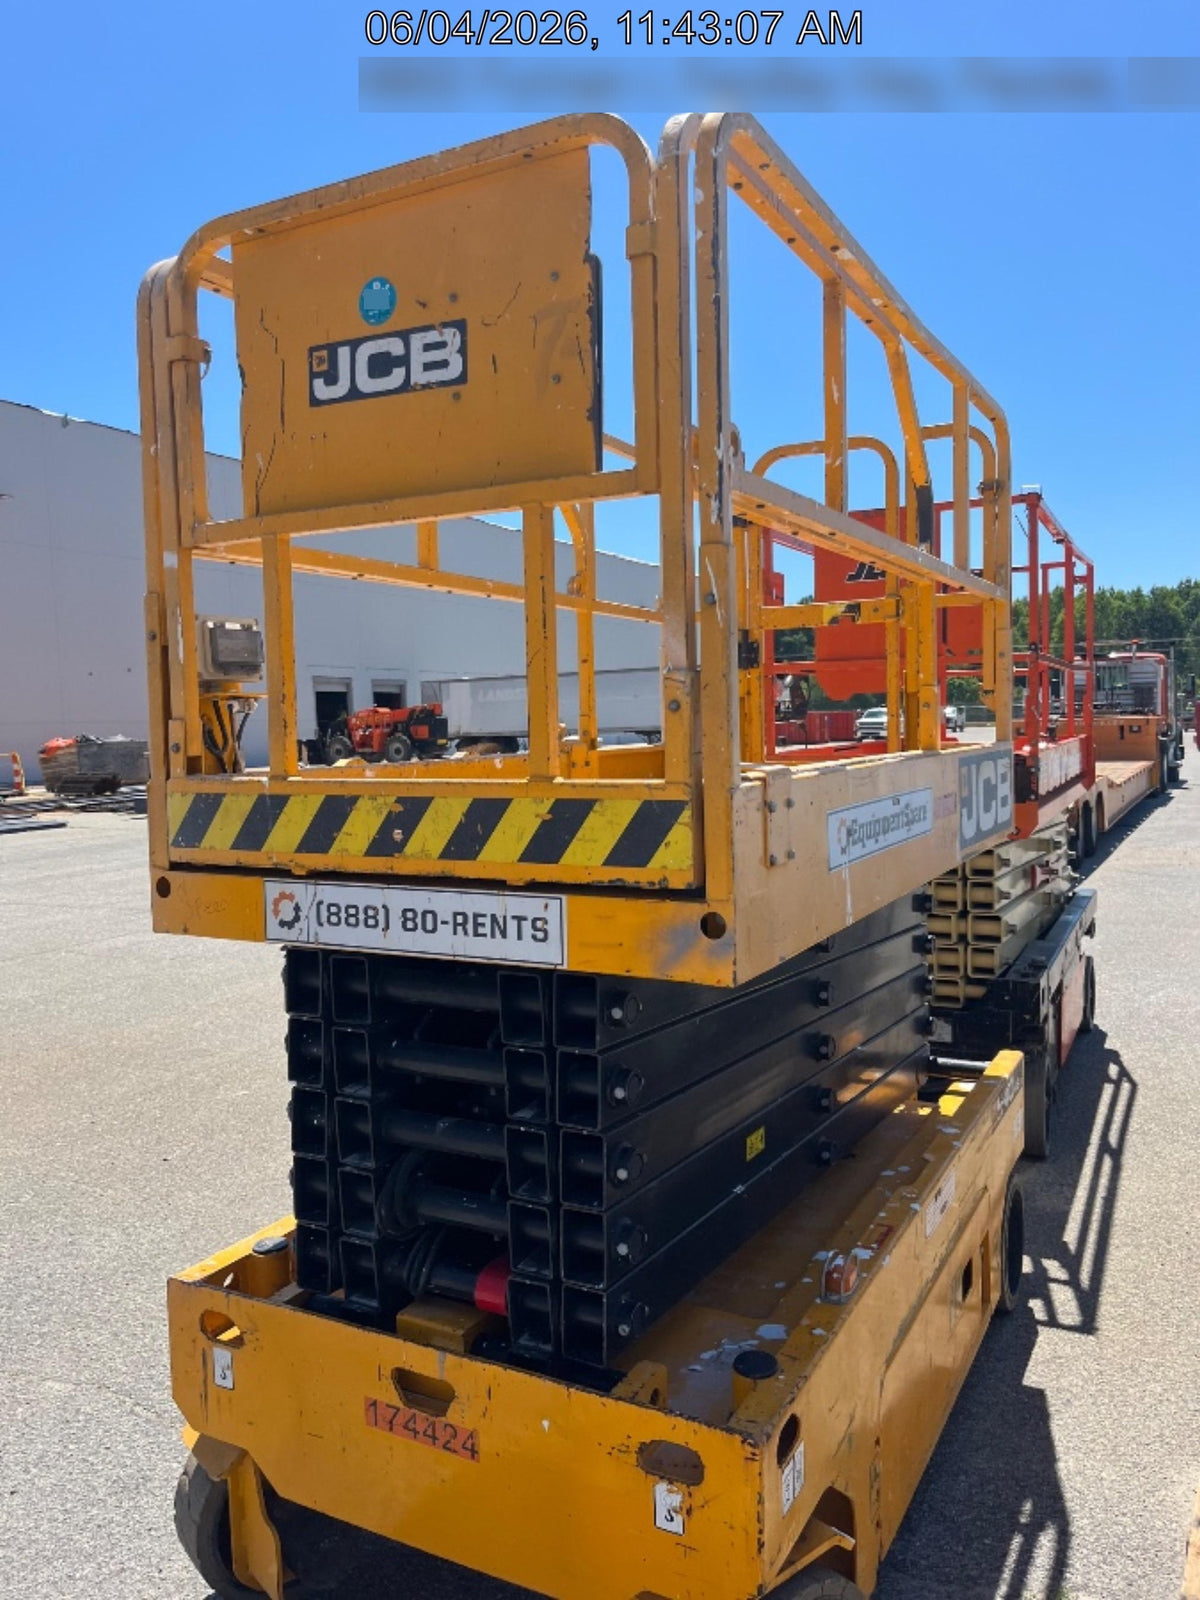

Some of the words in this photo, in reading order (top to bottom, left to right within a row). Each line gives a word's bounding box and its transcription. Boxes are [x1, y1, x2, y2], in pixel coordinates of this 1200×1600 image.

[312, 327, 463, 401] JCB
[961, 757, 1011, 840] JCB
[315, 899, 390, 932] (888)
[400, 907, 549, 943] 80-RENTS
[367, 1399, 479, 1461] 174424
